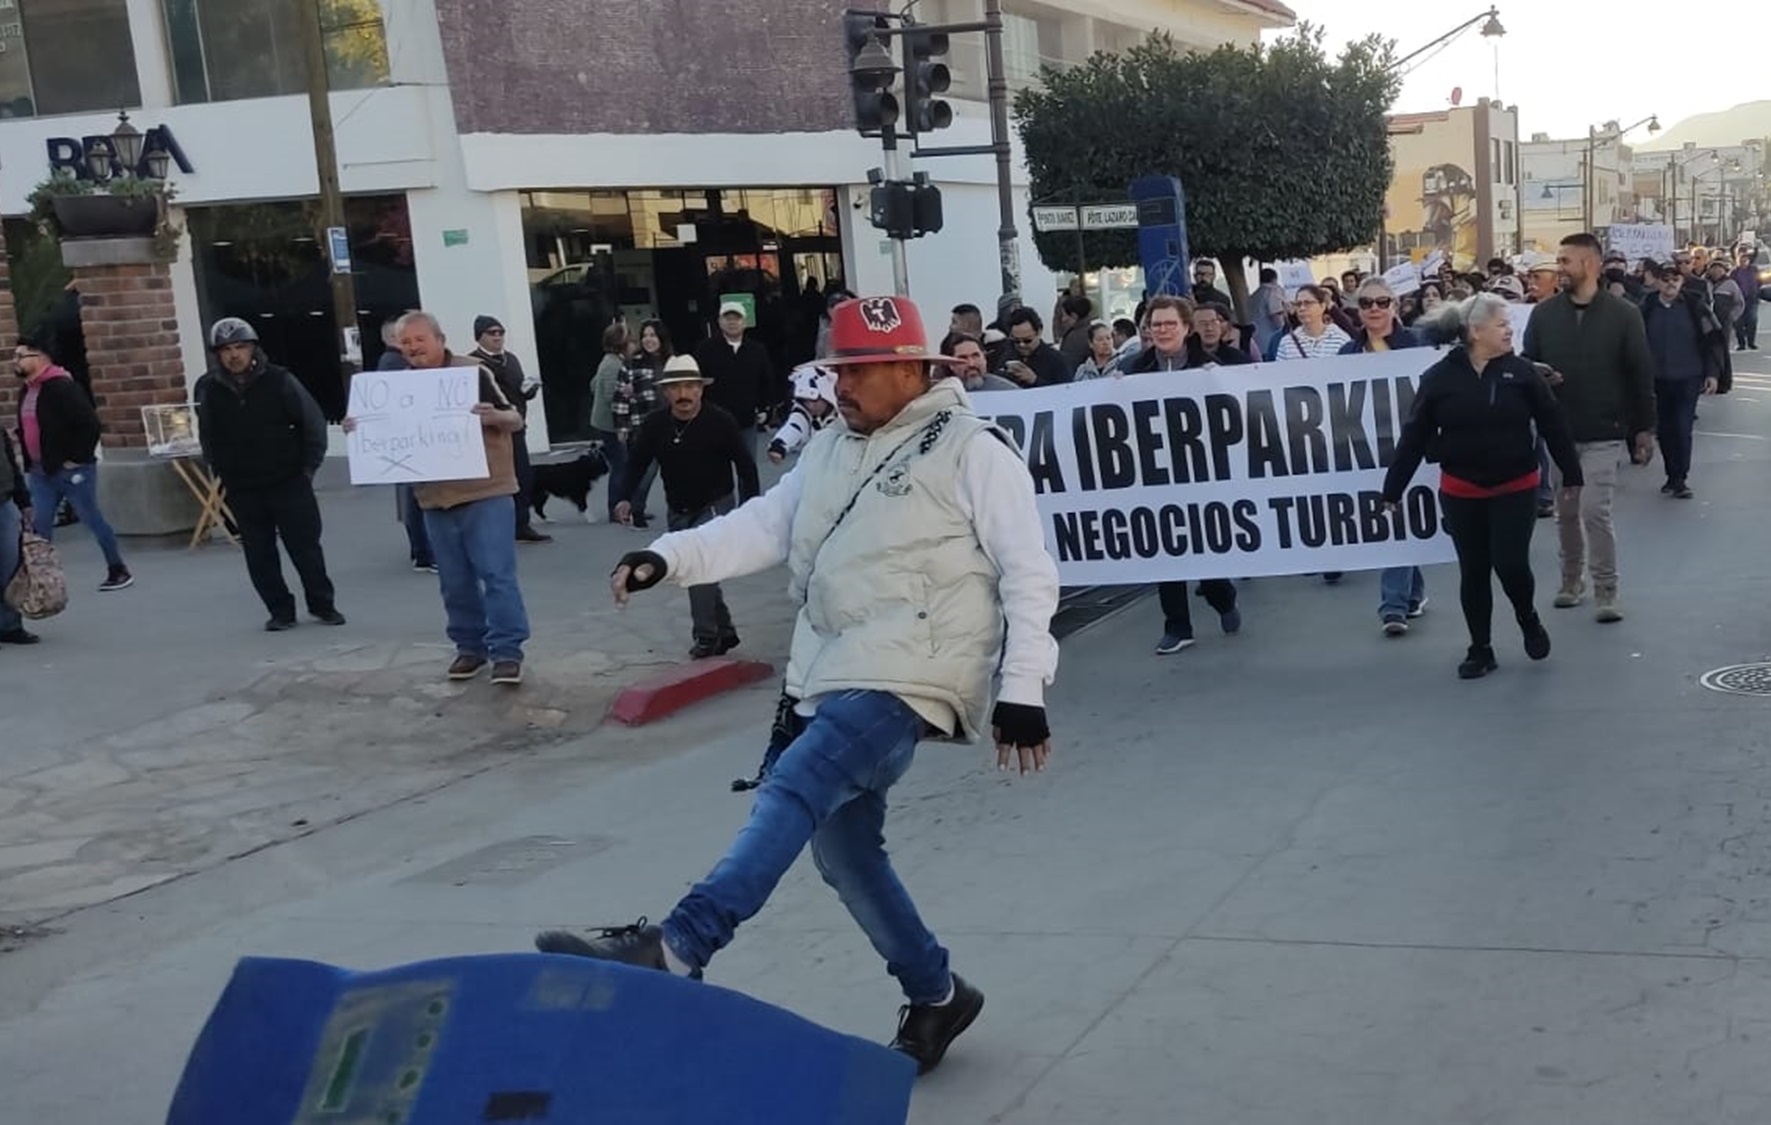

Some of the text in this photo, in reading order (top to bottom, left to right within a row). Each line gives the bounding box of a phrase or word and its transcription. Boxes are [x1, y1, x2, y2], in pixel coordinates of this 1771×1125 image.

[354, 376, 390, 411] NO
[400, 394, 414, 409] a
[1053, 485, 1452, 562] NEGOCIOS TURBIO
